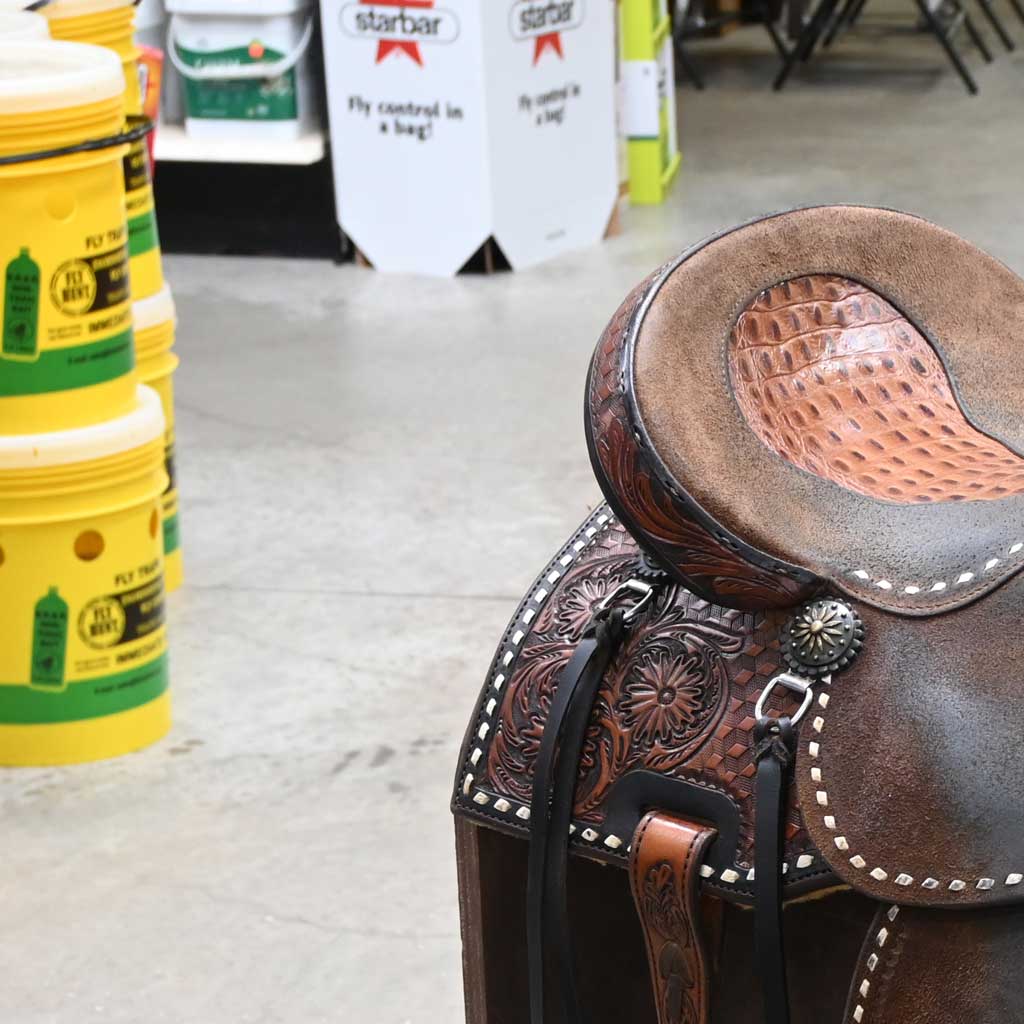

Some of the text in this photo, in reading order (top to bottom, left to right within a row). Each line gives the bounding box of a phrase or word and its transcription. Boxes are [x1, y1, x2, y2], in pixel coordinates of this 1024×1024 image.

[355, 7, 442, 36] starbar
[520, 0, 574, 31] starbar
[348, 96, 463, 118] Fly control in
[380, 120, 388, 134] a
[85, 232, 105, 251] FLY
